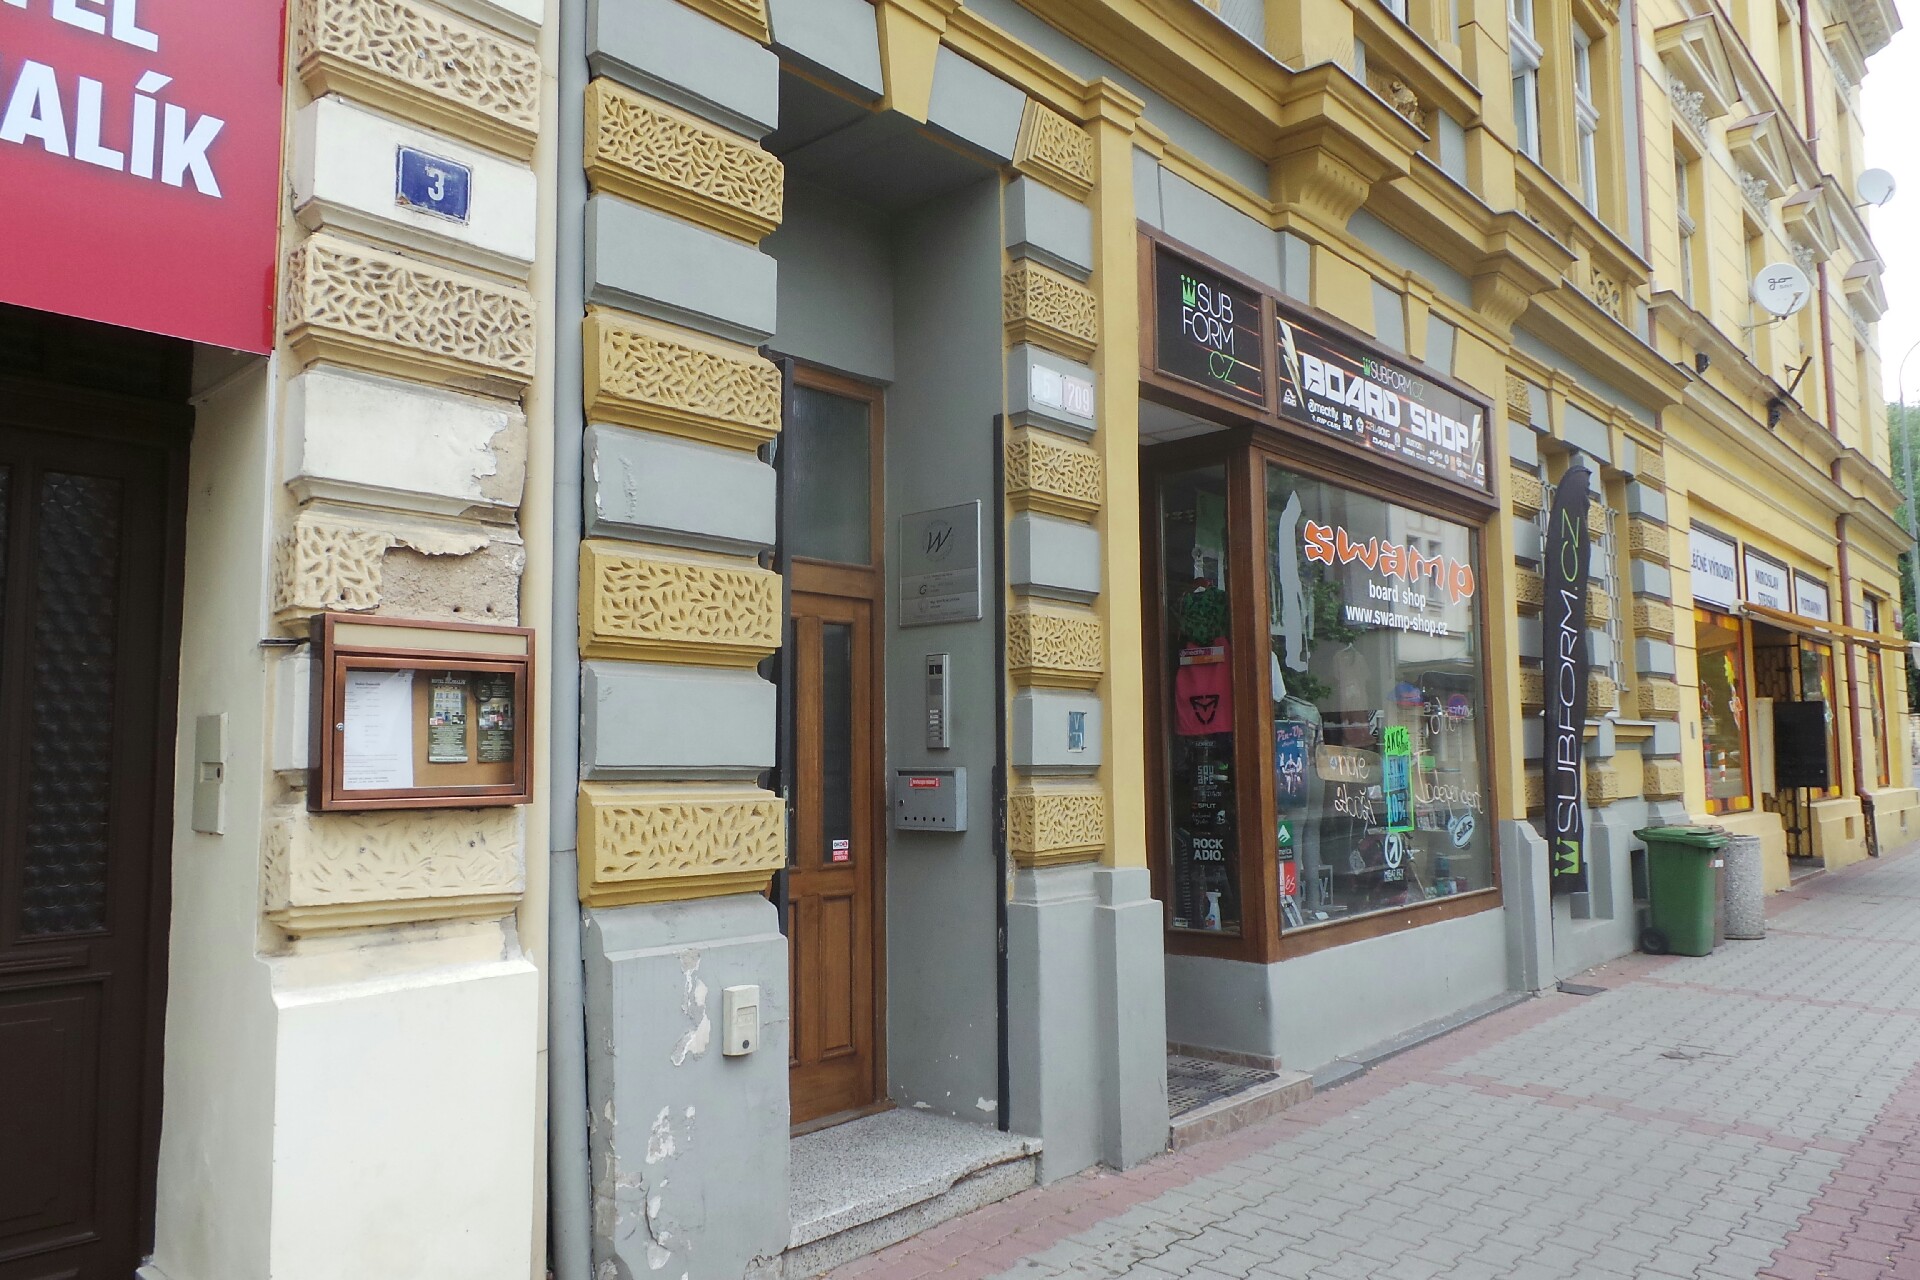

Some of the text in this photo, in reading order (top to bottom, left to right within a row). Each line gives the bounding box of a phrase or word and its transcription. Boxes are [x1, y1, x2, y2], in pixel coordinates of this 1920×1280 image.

[0, 60, 225, 198] ALÍK
[426, 167, 445, 202] 3
[1197, 282, 1234, 324] SUB
[1182, 305, 1235, 355] FORM
[1067, 382, 1090, 412] 709
[1303, 353, 1469, 454] BOARD SHOP
[1304, 519, 1475, 606] swamp
[1691, 548, 1708, 573] ÉČNÉ
[1368, 579, 1426, 612] board shop
[1755, 568, 1779, 591] MIROSLAV
[1345, 604, 1449, 638] www.swamp-shop.cz
[1386, 728, 1405, 753] AKCE
[1193, 838, 1224, 850] ROCK
